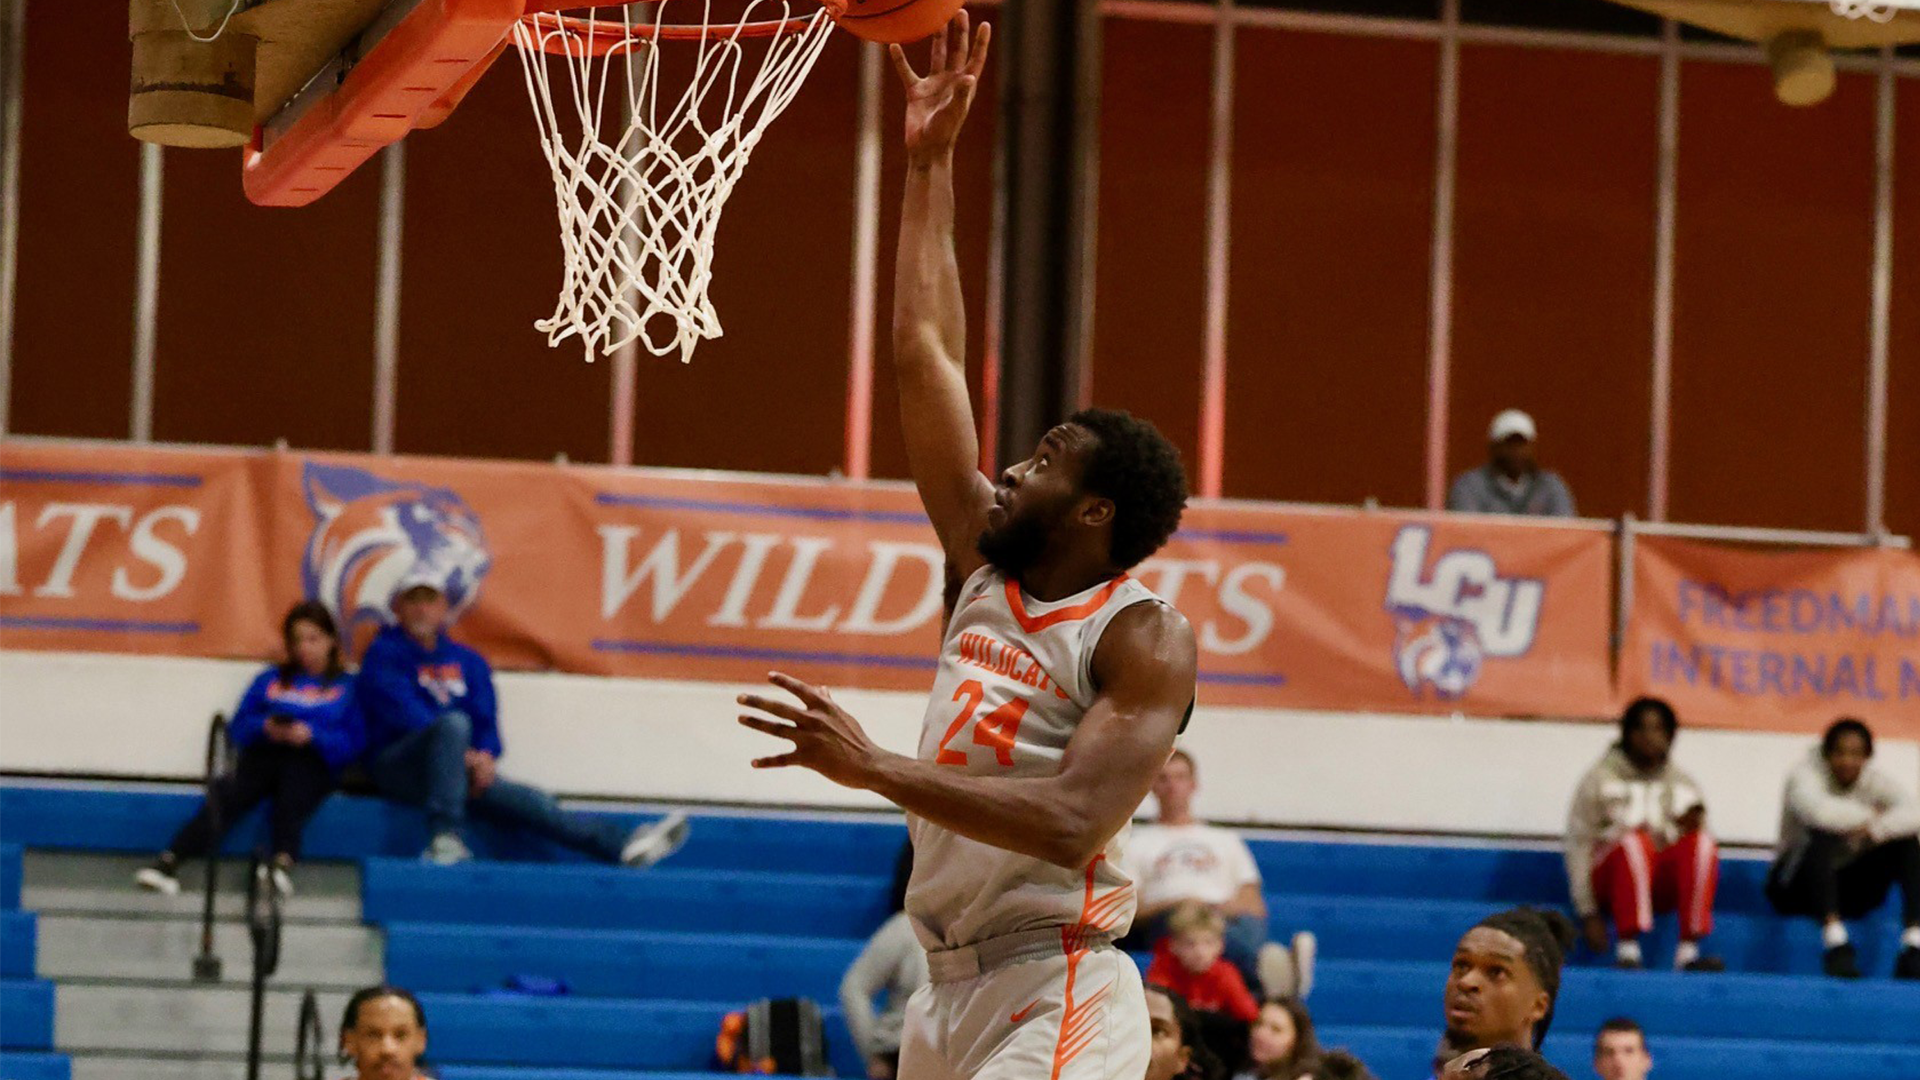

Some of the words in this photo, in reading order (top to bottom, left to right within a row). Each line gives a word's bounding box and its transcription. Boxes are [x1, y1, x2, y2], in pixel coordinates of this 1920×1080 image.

[0, 501, 201, 601] TS
[596, 525, 1285, 655] WILDTS
[1386, 526, 1544, 658] LCU
[1650, 640, 1886, 700] INTERNAL
[935, 679, 1030, 766] 24
